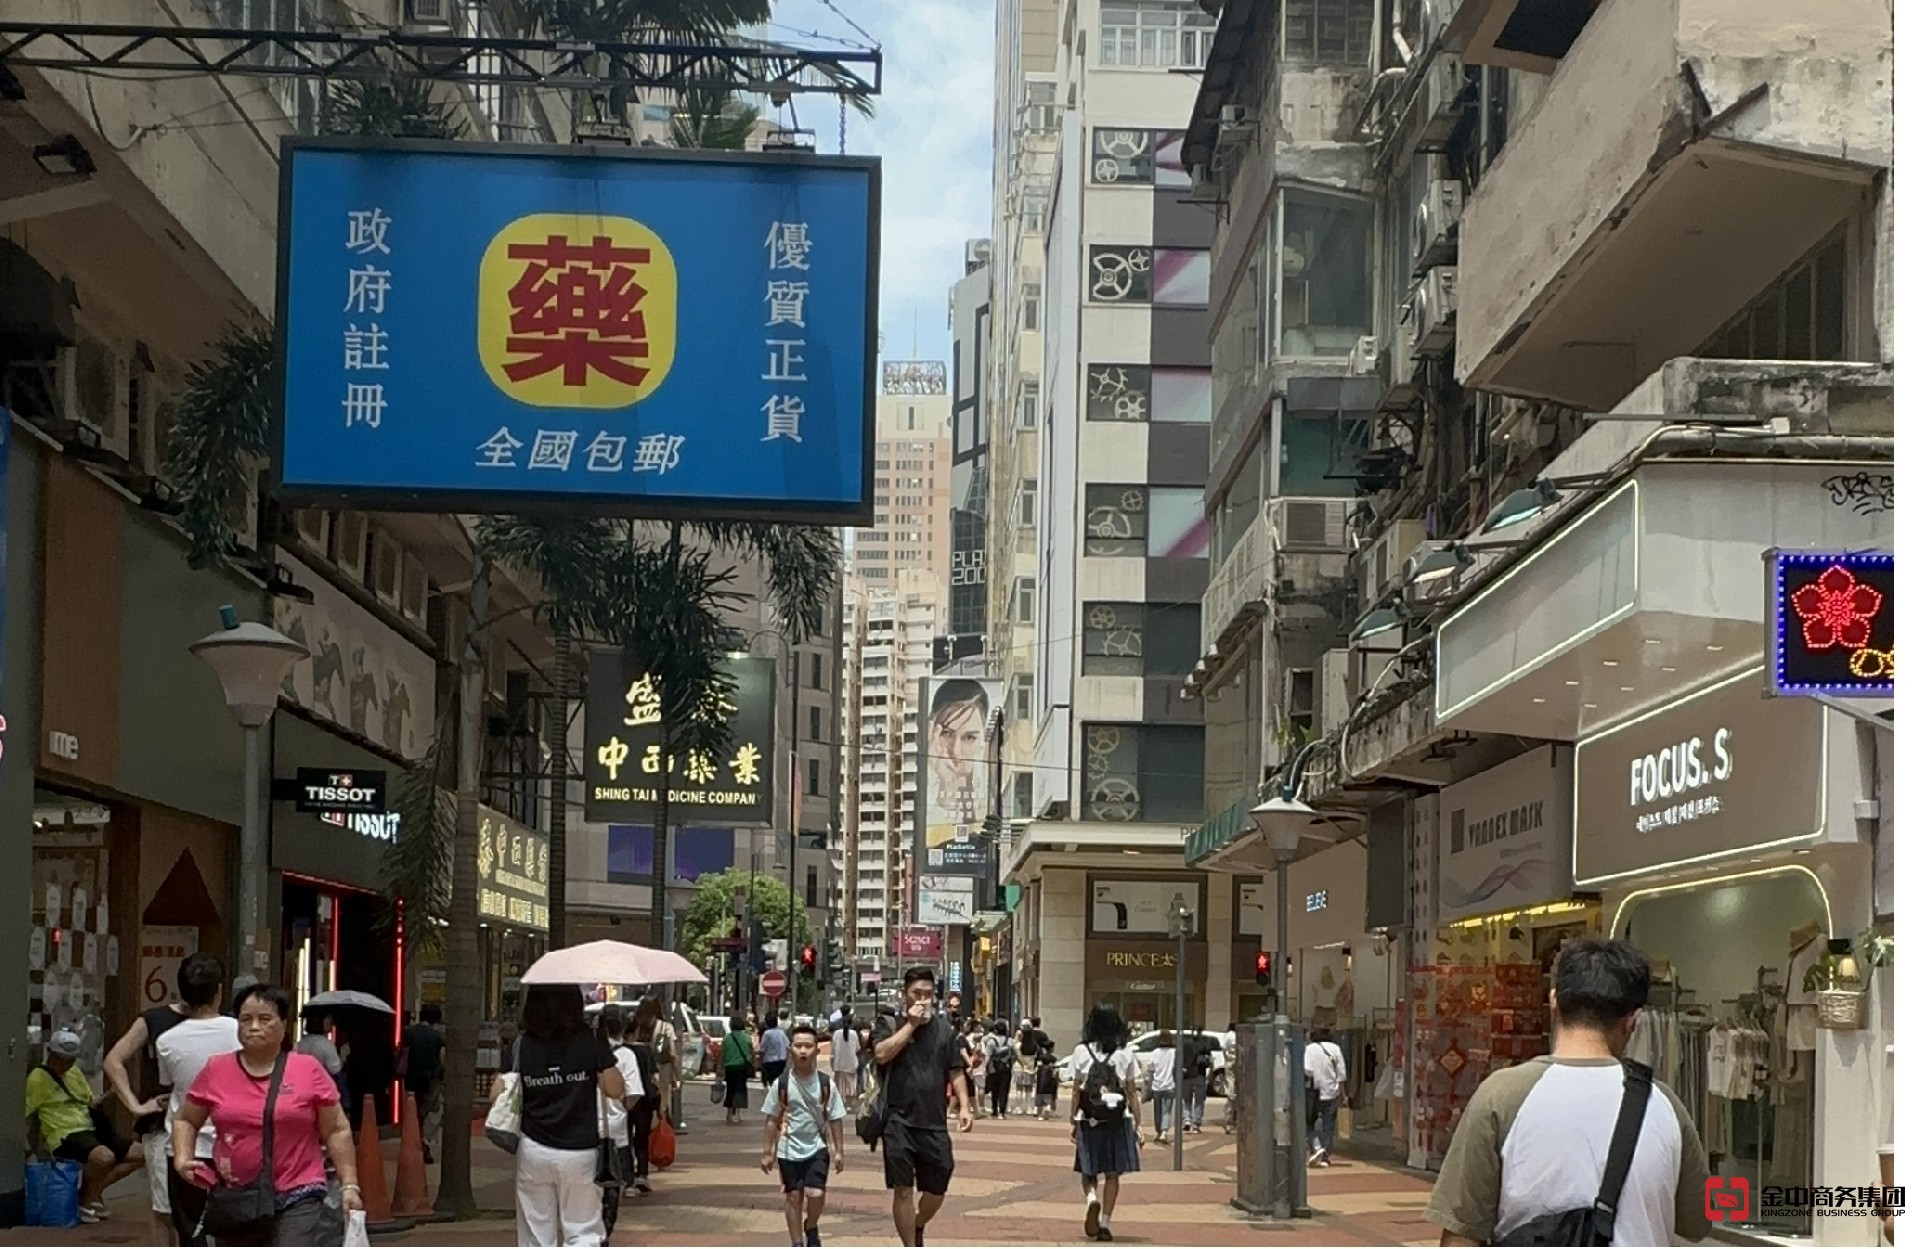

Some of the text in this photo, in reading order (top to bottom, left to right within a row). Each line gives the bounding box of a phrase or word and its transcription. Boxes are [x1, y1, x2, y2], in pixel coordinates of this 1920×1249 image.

[341, 207, 392, 428] 政府註冊
[500, 234, 651, 387] 藥
[760, 220, 813, 443] 優質正貨
[475, 426, 686, 475] 全國包郵
[952, 549, 985, 567] PLA
[305, 786, 376, 802] TISSOT
[595, 788, 630, 801] SHING
[651, 790, 706, 803] MDICINE
